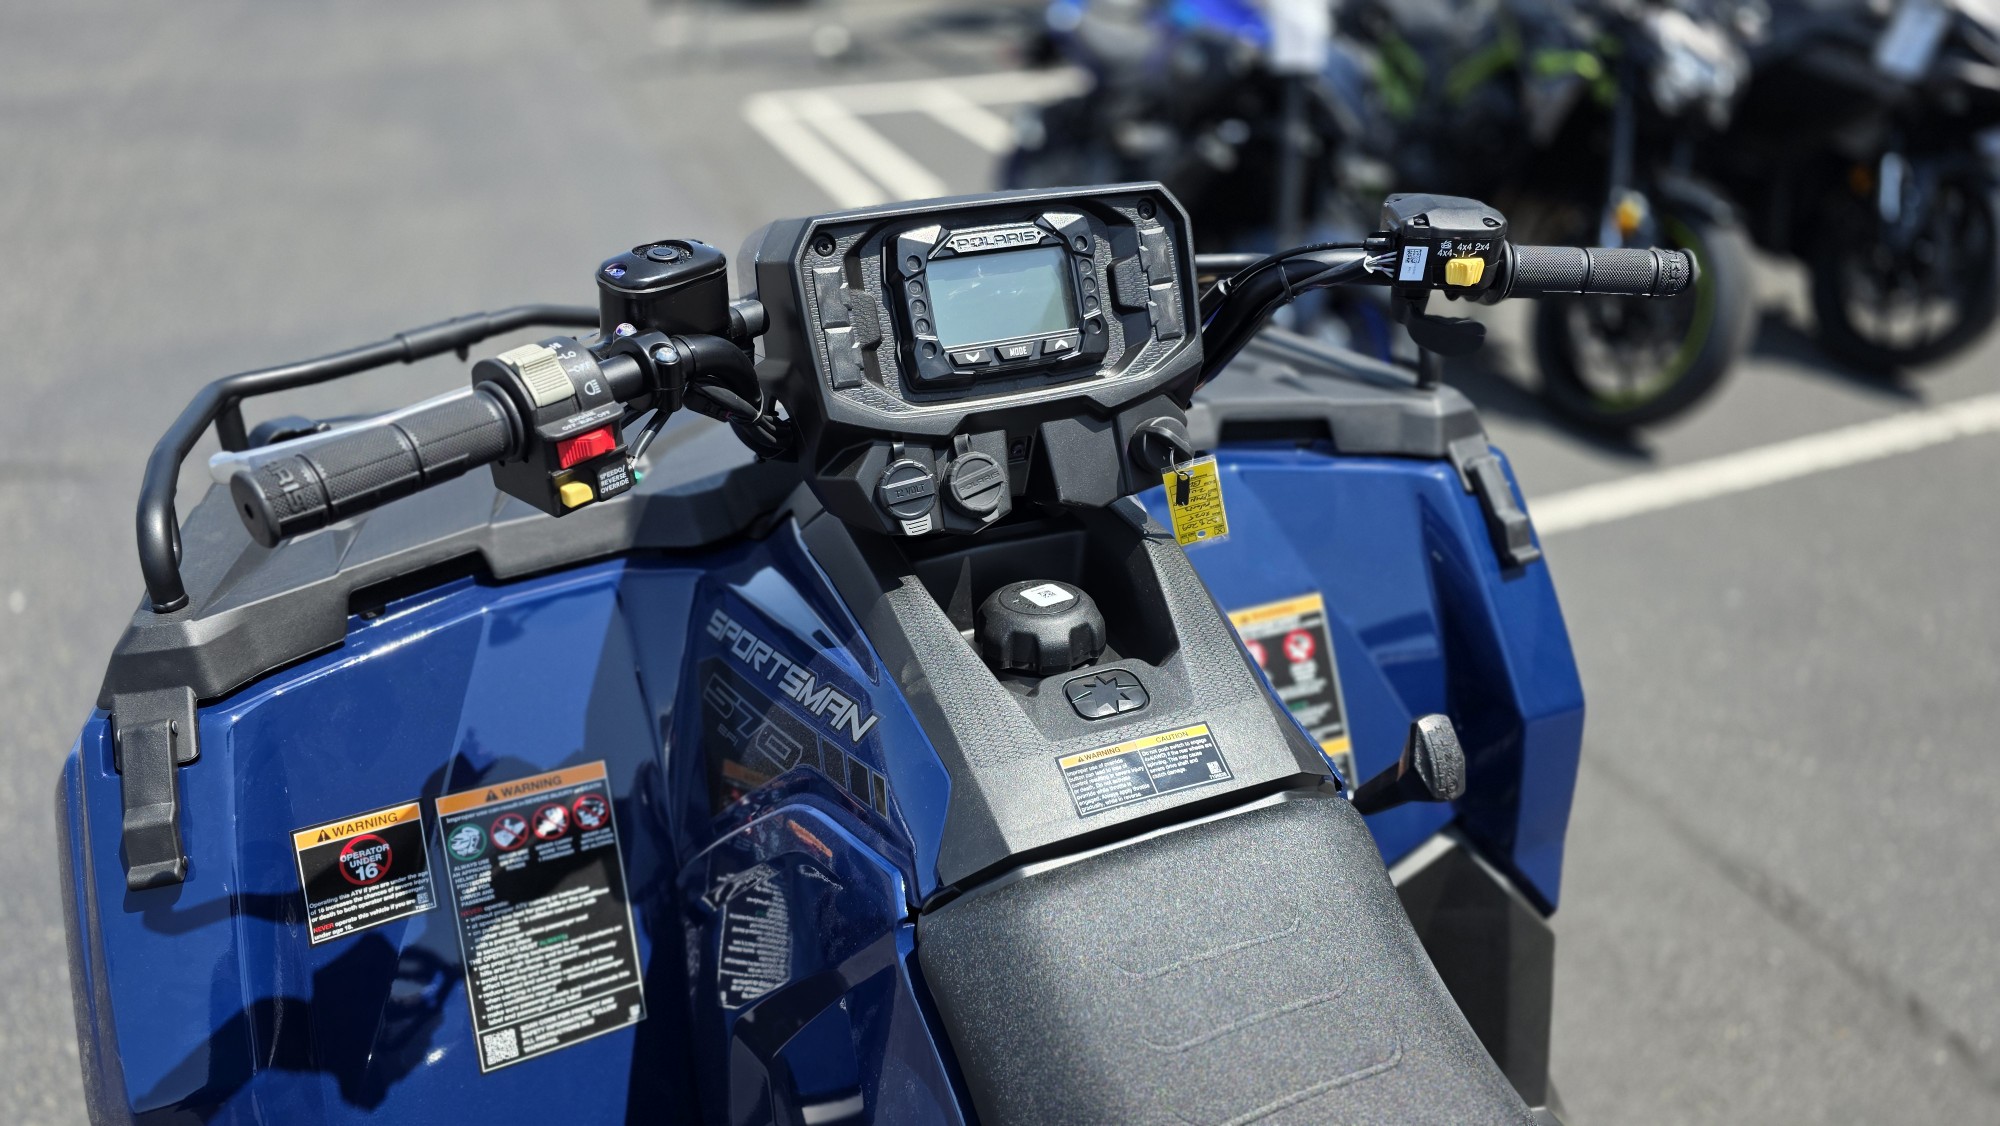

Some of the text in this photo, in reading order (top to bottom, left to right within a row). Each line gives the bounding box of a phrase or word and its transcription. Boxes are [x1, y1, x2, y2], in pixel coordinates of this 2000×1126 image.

[956, 231, 1037, 250] POLARIS
[1457, 243, 1490, 251] 4x4 2x4
[1437, 249, 1453, 257] 4x4
[1009, 345, 1028, 357] MODE
[600, 465, 625, 480] SPEEDO/
[600, 472, 626, 487] REVERSE
[601, 478, 629, 493] OVERRIDE
[905, 484, 925, 495] VOLT
[706, 608, 878, 743] SPORTSMAN
[1155, 730, 1188, 742] CAUTION
[1084, 747, 1120, 759] WARNING
[501, 775, 561, 797] WARNING
[332, 812, 396, 836] WARNING
[446, 811, 474, 823] Improper
[340, 843, 389, 862] OPERATOR
[349, 853, 381, 867] UNDER
[356, 862, 378, 880] 16
[453, 861, 477, 871] ALWAYS
[309, 896, 337, 909] Operating
[368, 884, 379, 892] you
[325, 899, 352, 910] increases
[363, 889, 386, 899] chances
[319, 911, 335, 919] death
[344, 904, 356, 912] both
[358, 897, 382, 908] operator
[313, 923, 333, 932] NEVER
[334, 915, 356, 926] operate
[358, 911, 368, 919] this
[370, 905, 389, 915] vehicle
[314, 930, 331, 939] under
